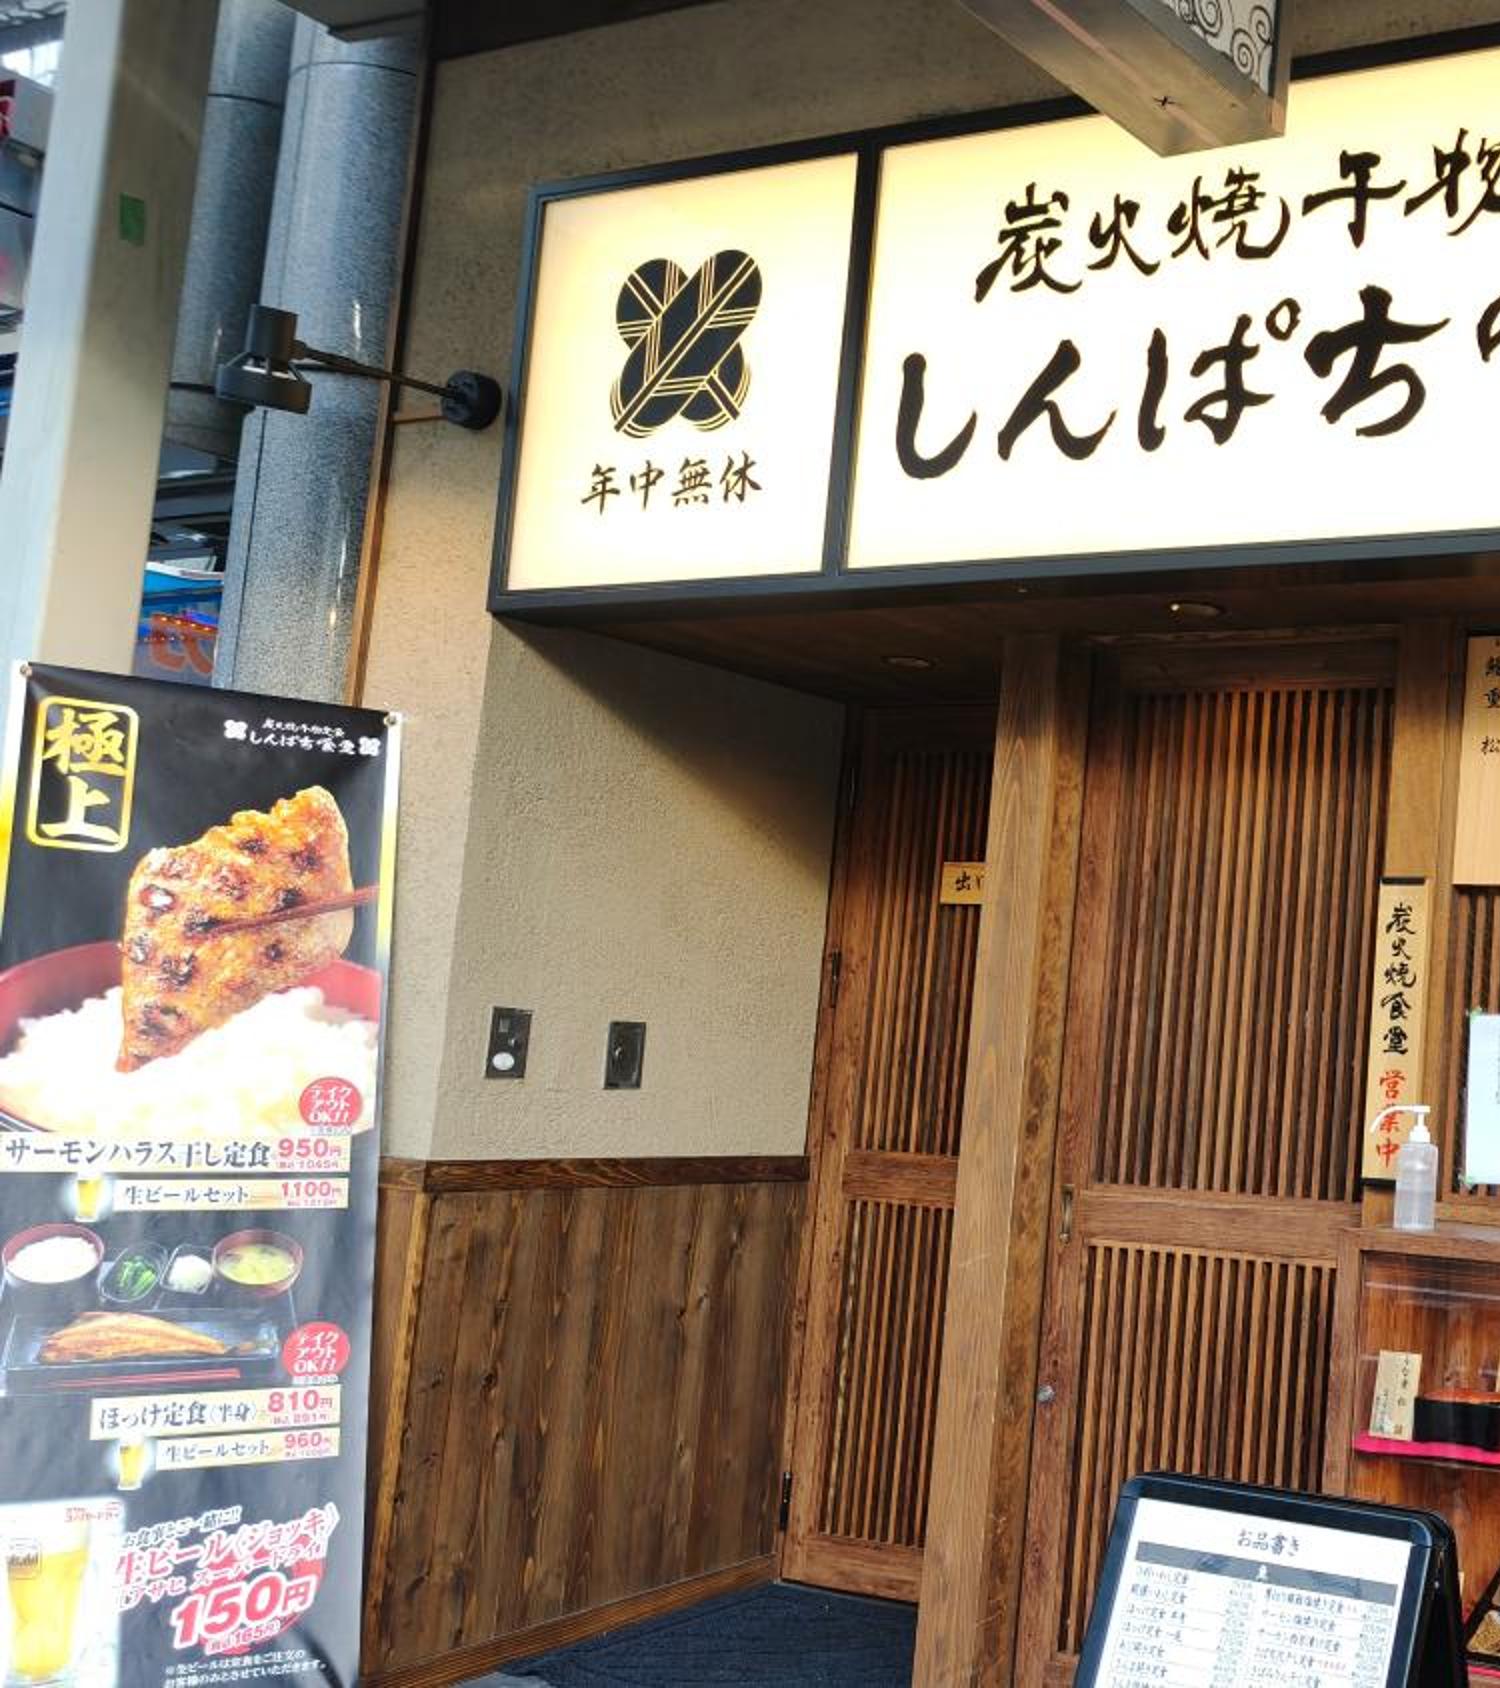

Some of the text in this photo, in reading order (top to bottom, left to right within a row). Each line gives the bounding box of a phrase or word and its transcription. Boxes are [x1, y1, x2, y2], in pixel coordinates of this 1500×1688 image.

[580, 450, 764, 516] 年中無休
[41, 705, 127, 847] 極上
[1380, 902, 1417, 1055] 炭火焼食堂
[6, 1138, 271, 1169] サーモンハラス干し定食
[278, 1138, 341, 1158] 950円
[125, 1186, 249, 1206] 生ビールセット
[281, 1182, 341, 1197] 1100円
[100, 1401, 206, 1429] ほっけ定食
[267, 1390, 333, 1412] 810円
[165, 1441, 268, 1462] 生ビールセット
[1237, 1528, 1300, 1557] お品書き
[176, 1577, 314, 1648] 150円
